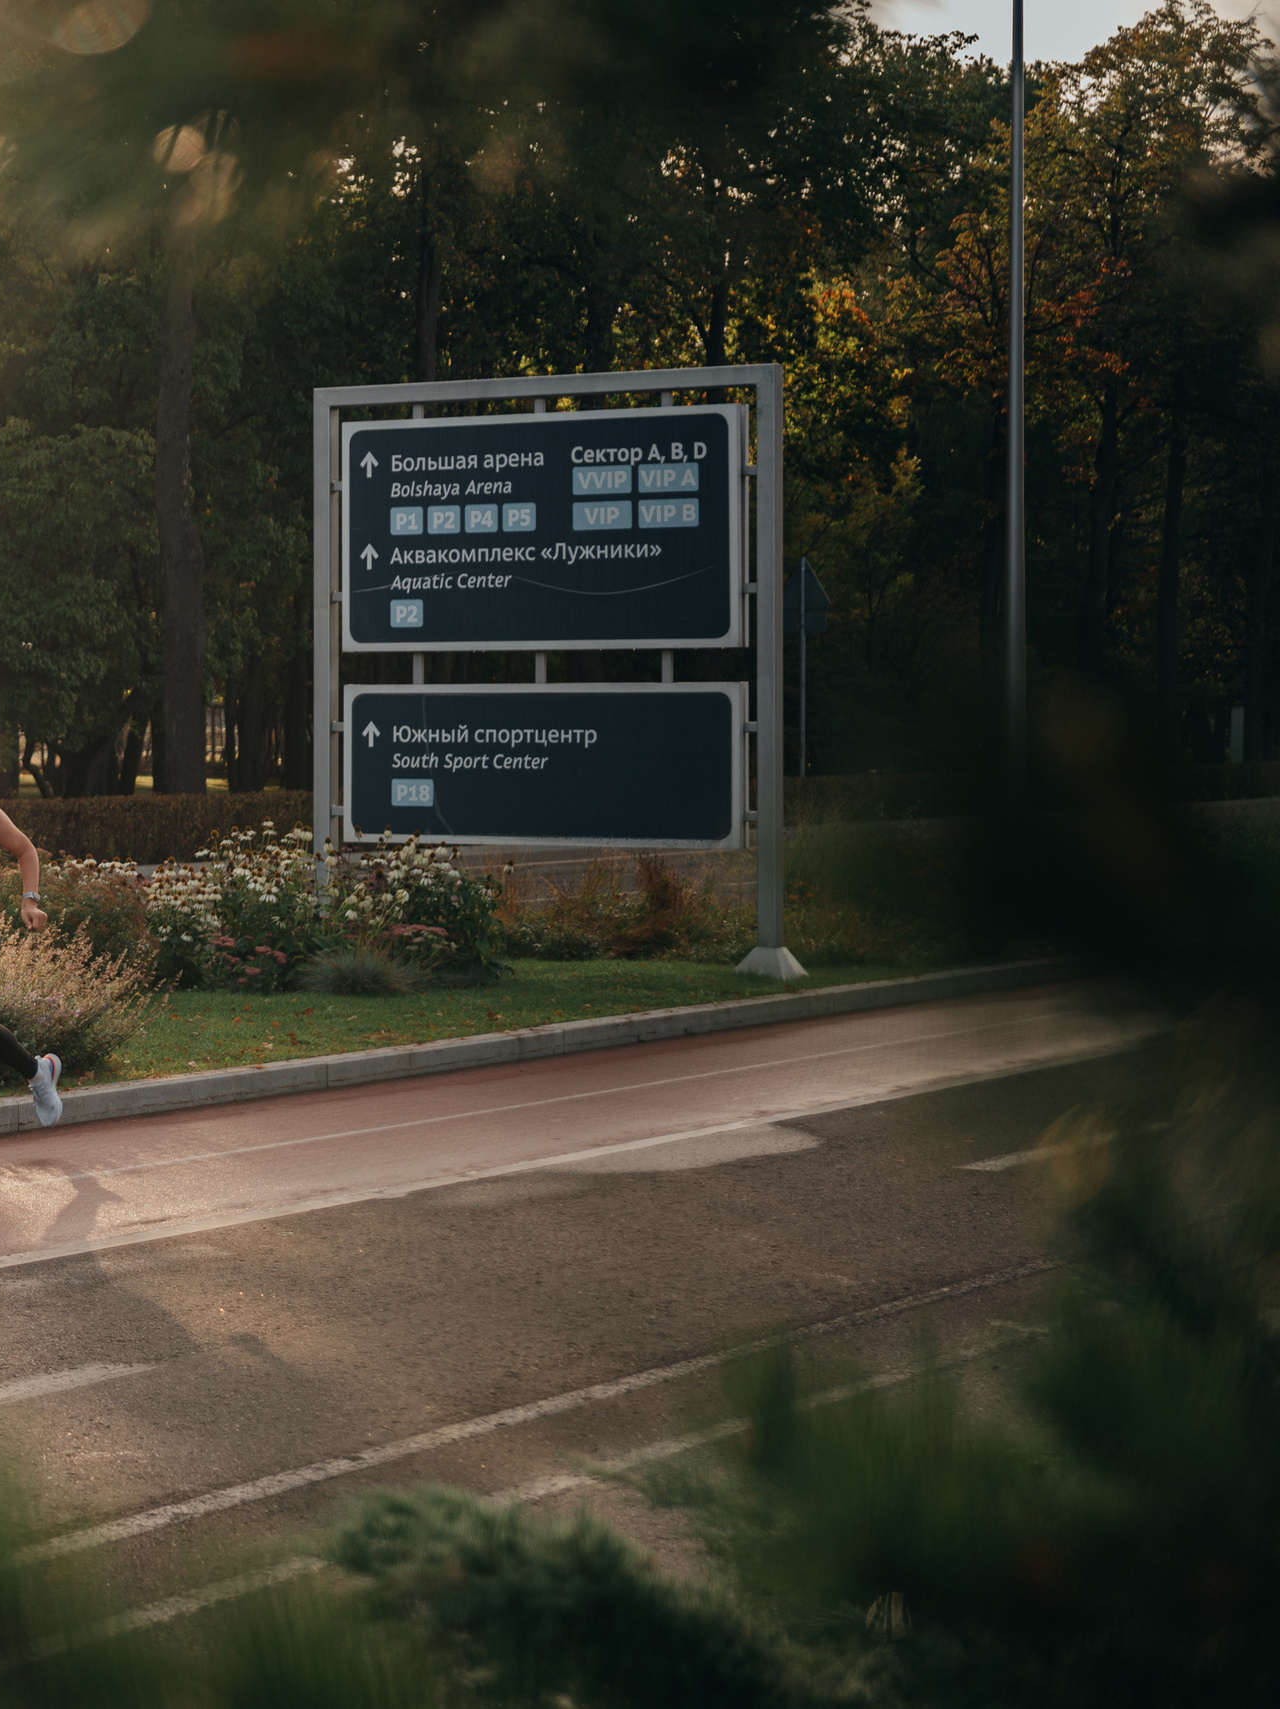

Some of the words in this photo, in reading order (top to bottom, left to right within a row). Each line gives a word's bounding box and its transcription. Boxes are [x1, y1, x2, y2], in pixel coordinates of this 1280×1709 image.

[391, 453, 478, 472] Большая
[483, 451, 545, 472] арена
[571, 445, 643, 465] Сектор
[693, 441, 707, 460] D
[577, 470, 627, 490] VVIP
[640, 468, 676, 488] VIP
[680, 468, 697, 487] A
[390, 480, 461, 500] Bolshaya
[465, 479, 512, 496] Arena
[396, 512, 418, 531] P1
[432, 512, 455, 530] P2
[470, 510, 493, 528] P4
[508, 509, 531, 527] P5
[584, 507, 620, 525] VIP
[640, 505, 676, 523] VIP
[390, 544, 536, 565] Аквакомплекс
[541, 542, 662, 565] «Лужники»
[390, 572, 453, 594] Aquatic
[457, 572, 512, 589] Center
[396, 605, 418, 623] P2
[392, 724, 469, 743] Южный
[474, 727, 598, 748] спортцентр
[392, 753, 439, 769] South
[443, 753, 489, 772] Sport
[493, 753, 549, 770] Center
[396, 784, 430, 803] P18
